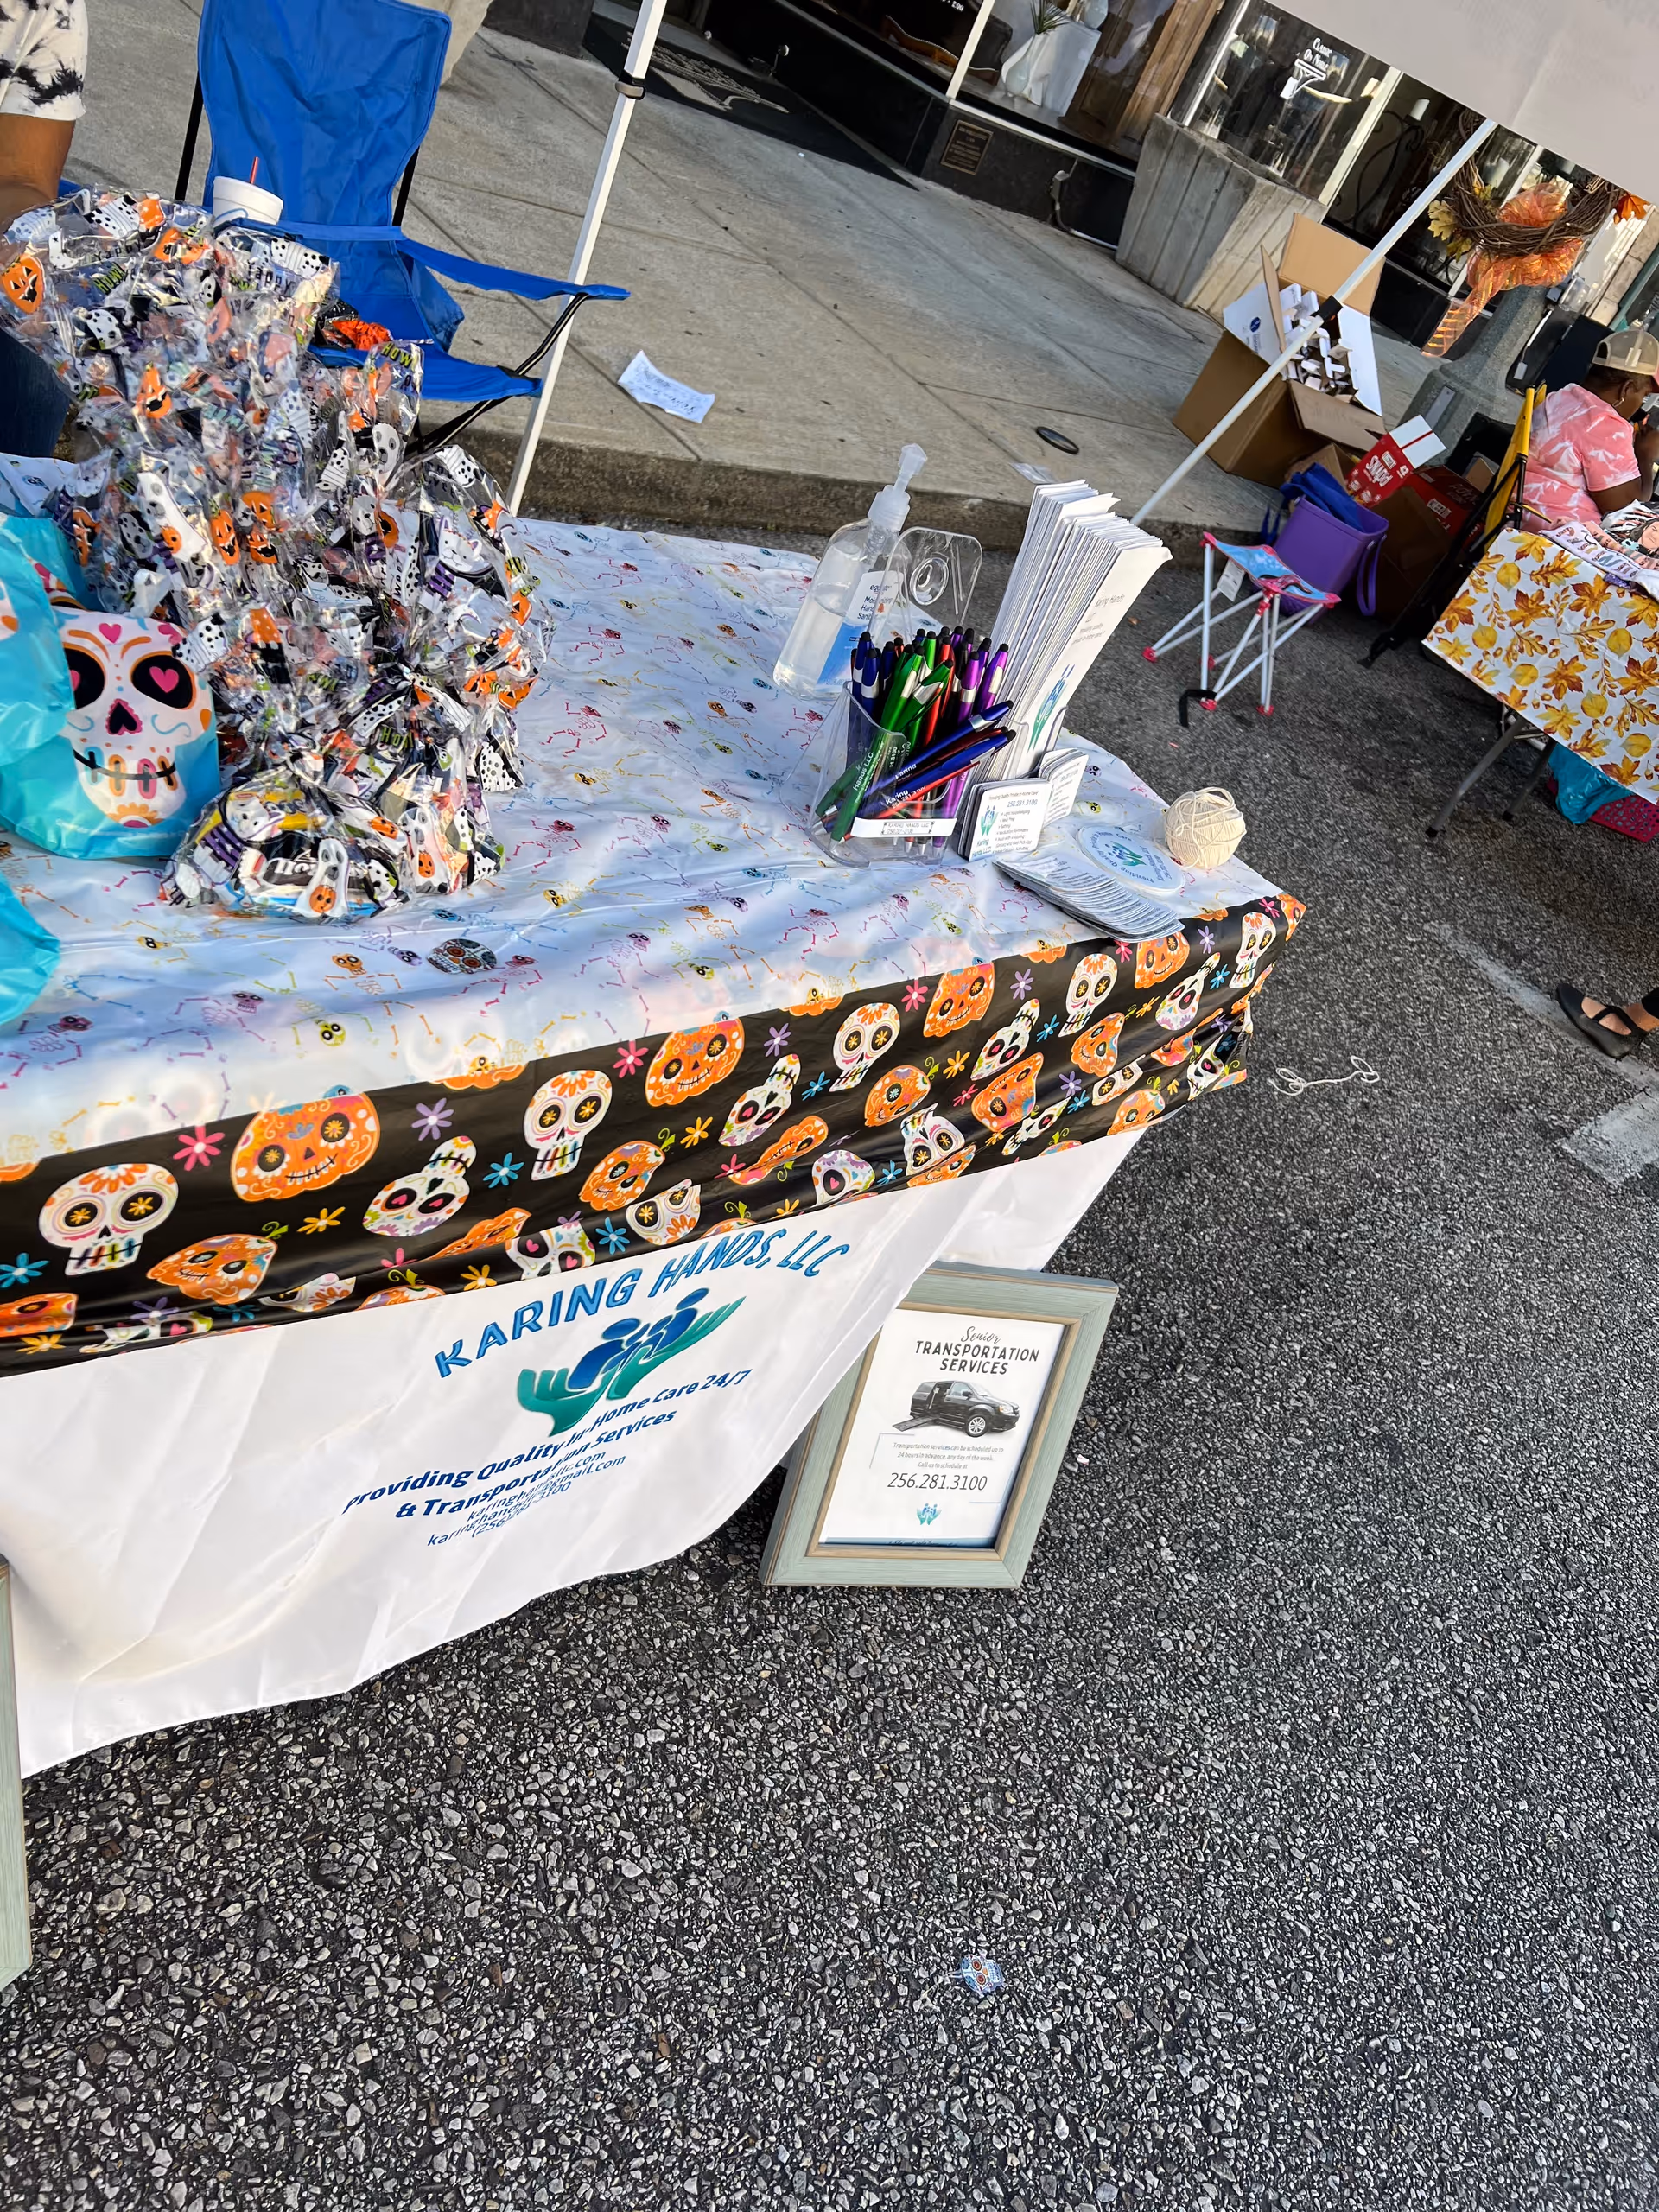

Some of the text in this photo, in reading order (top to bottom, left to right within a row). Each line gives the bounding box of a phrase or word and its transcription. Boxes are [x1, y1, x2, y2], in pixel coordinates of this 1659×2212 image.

[434, 1227, 851, 1379] KARING HANDS, LLC
[960, 1325, 1001, 1344] Senior
[914, 1339, 1040, 1362] TRANSPORTATION
[938, 1357, 1009, 1376] SERVICES
[476, 1440, 567, 1482] Quality
[650, 1381, 701, 1404] Care
[697, 1368, 753, 1391] 24/7
[930, 1443, 950, 1452] services
[395, 1502, 417, 1518] &
[590, 1409, 678, 1450] Services
[887, 1472, 988, 1491] 256.281.3100
